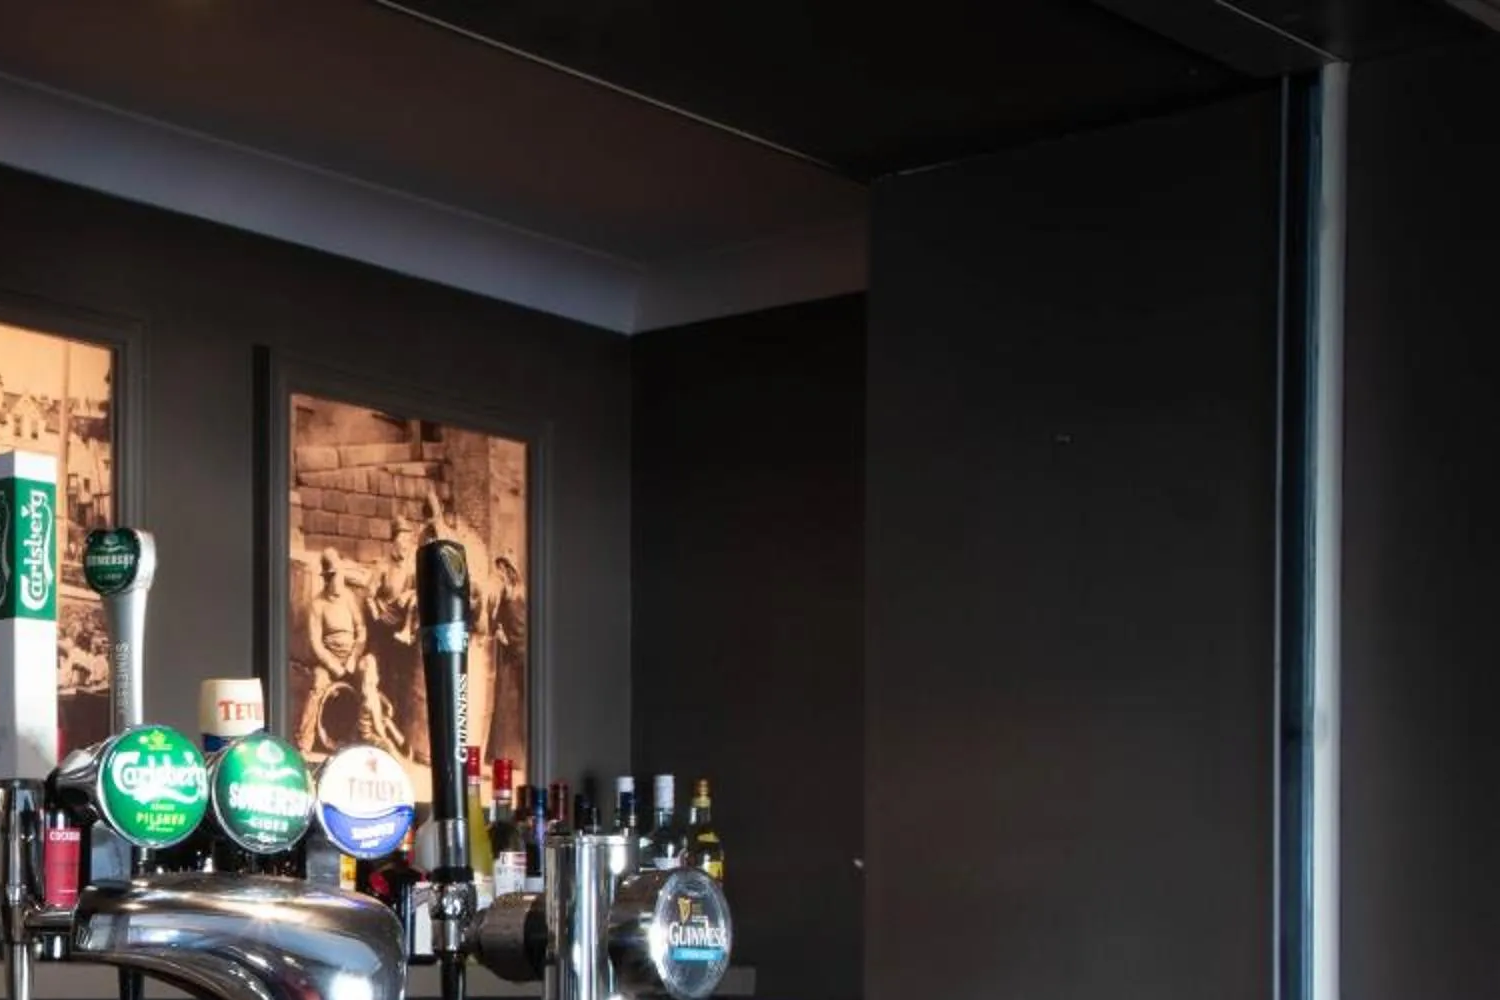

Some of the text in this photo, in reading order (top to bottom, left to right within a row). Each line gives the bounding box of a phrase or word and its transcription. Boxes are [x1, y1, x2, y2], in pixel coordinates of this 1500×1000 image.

[20, 489, 53, 611] Carlsberg
[454, 672, 468, 763] GUINNESS
[112, 751, 207, 804] Carlsberg
[669, 921, 727, 948] GUINNESS
